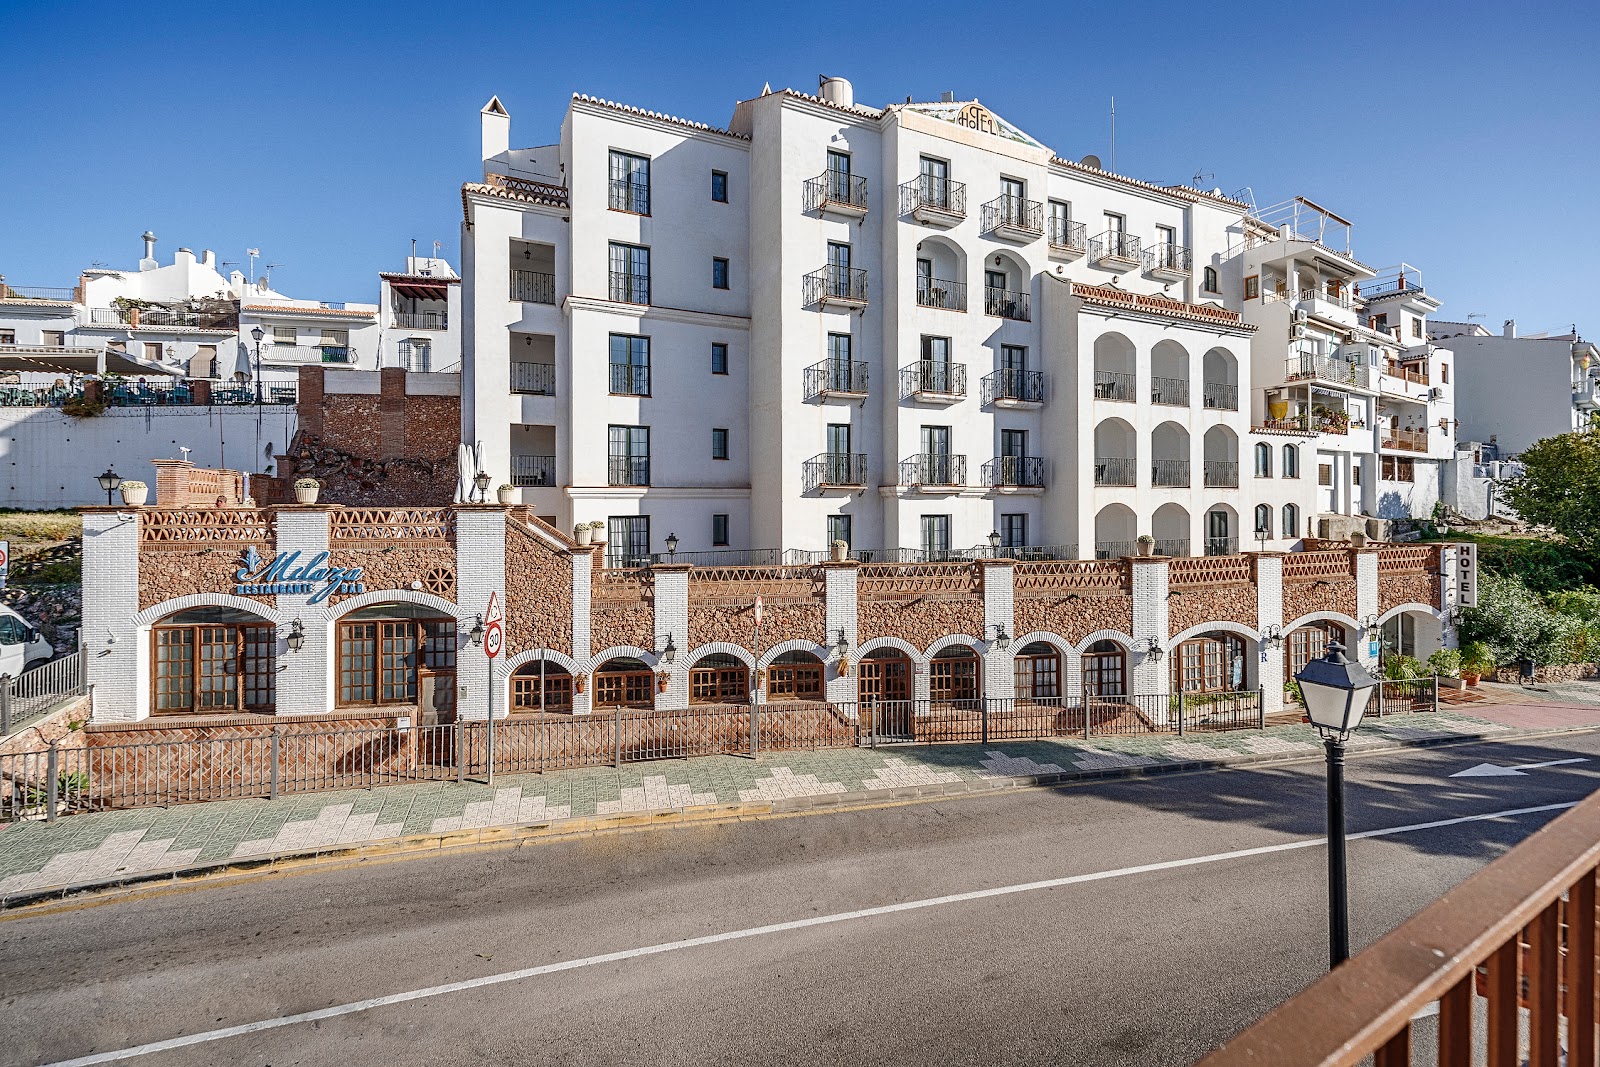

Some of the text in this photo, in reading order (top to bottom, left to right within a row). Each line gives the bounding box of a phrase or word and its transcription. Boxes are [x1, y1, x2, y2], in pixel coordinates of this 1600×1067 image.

[1460, 546, 1470, 604] HOTEL
[236, 583, 364, 595] RESTAURANTE BAR
[489, 633, 499, 648] 30
[1261, 652, 1268, 662] R
